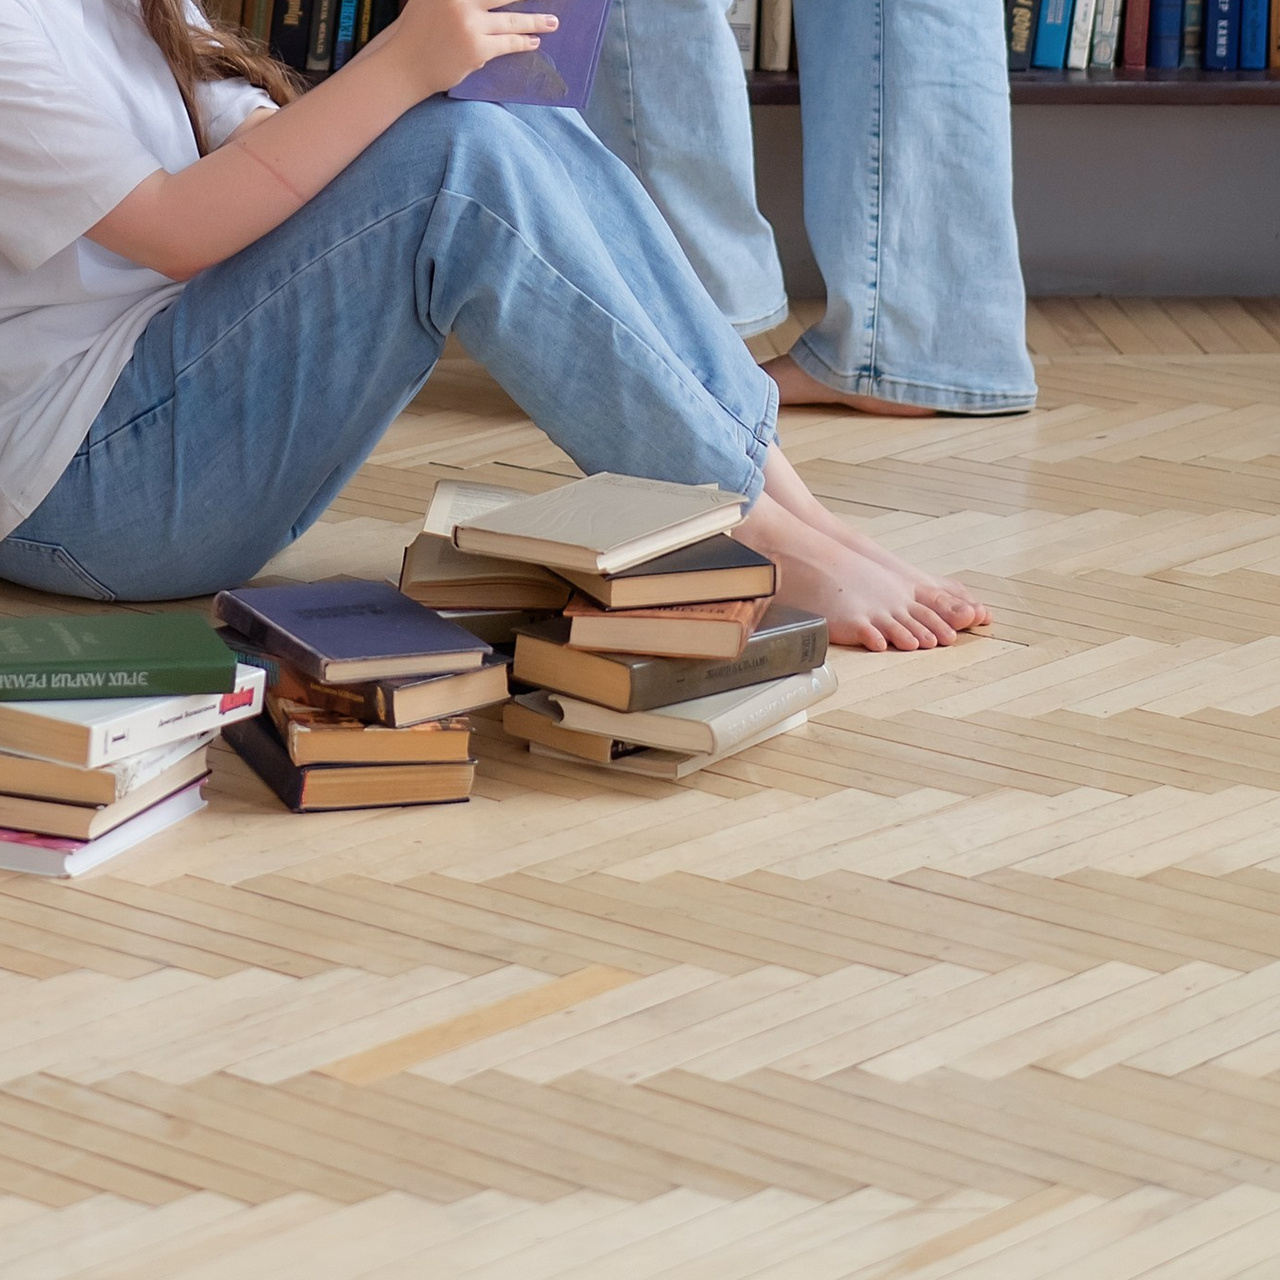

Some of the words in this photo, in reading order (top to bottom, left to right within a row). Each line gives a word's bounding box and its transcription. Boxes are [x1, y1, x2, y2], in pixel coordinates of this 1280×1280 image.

[1215, 18, 1229, 57] КАМЮ
[51, 673, 107, 689] МАРИЯ
[109, 671, 150, 687] ЭРИХ
